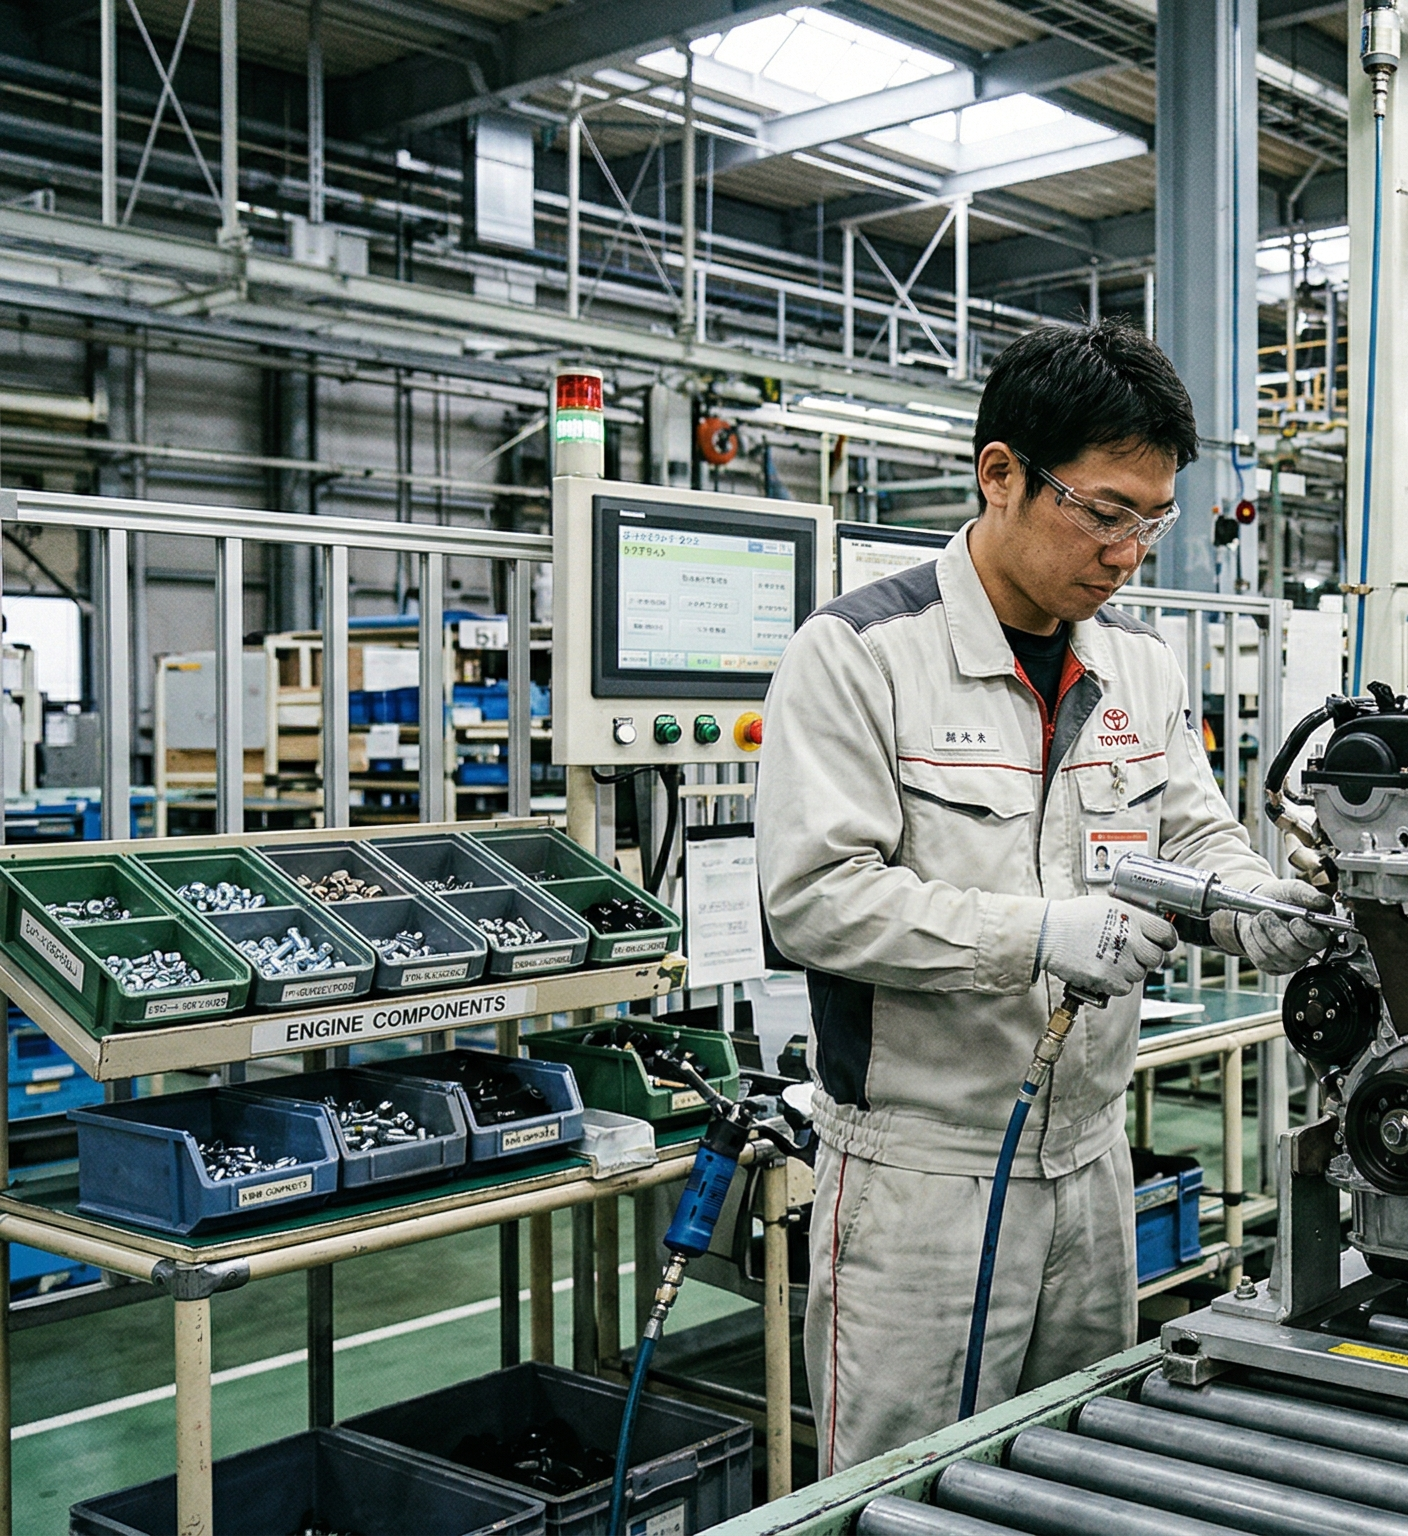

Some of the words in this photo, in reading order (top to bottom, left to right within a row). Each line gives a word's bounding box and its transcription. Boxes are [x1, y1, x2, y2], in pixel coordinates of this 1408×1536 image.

[1097, 733, 1140, 746] TOYOTA
[287, 1015, 363, 1042] ENGINE
[373, 995, 506, 1029] COMPONENTS
